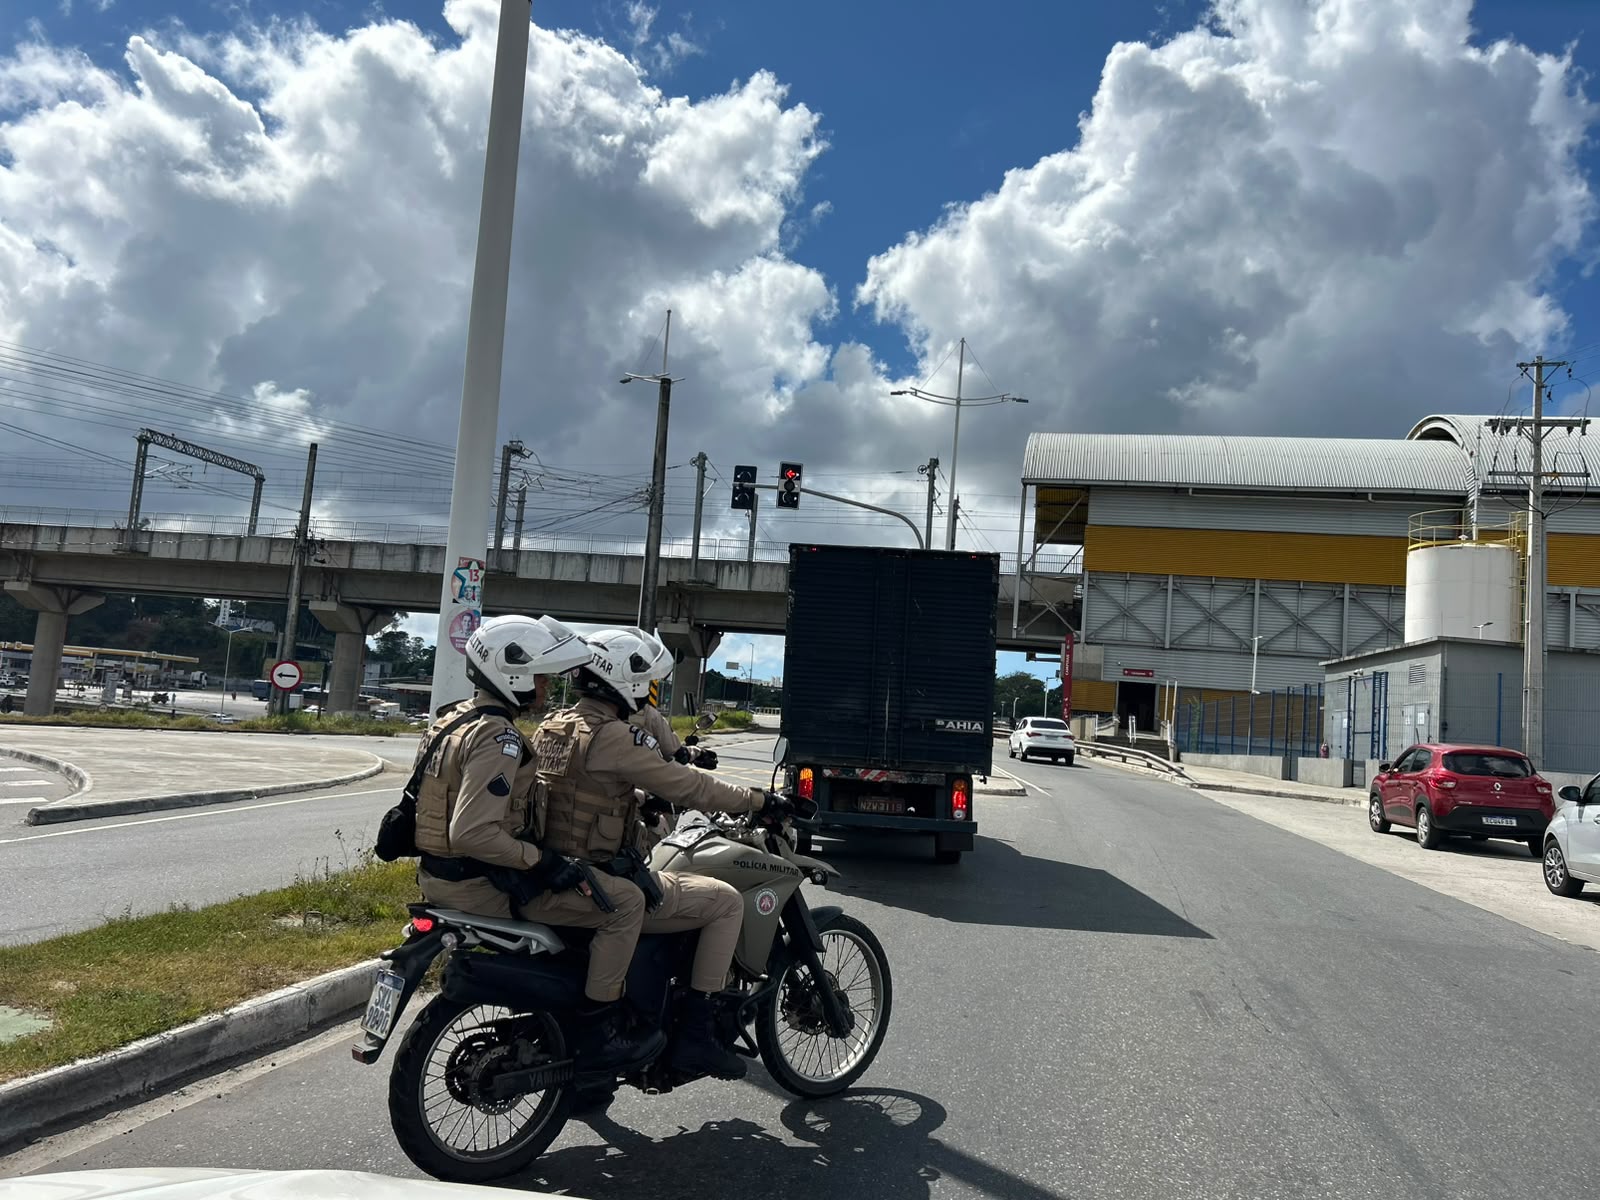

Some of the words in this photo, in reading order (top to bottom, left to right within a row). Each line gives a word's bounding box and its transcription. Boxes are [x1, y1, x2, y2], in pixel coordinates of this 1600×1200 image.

[468, 569, 480, 582] 13
[592, 652, 613, 675] ITAR
[769, 864, 799, 877] MILITAR
